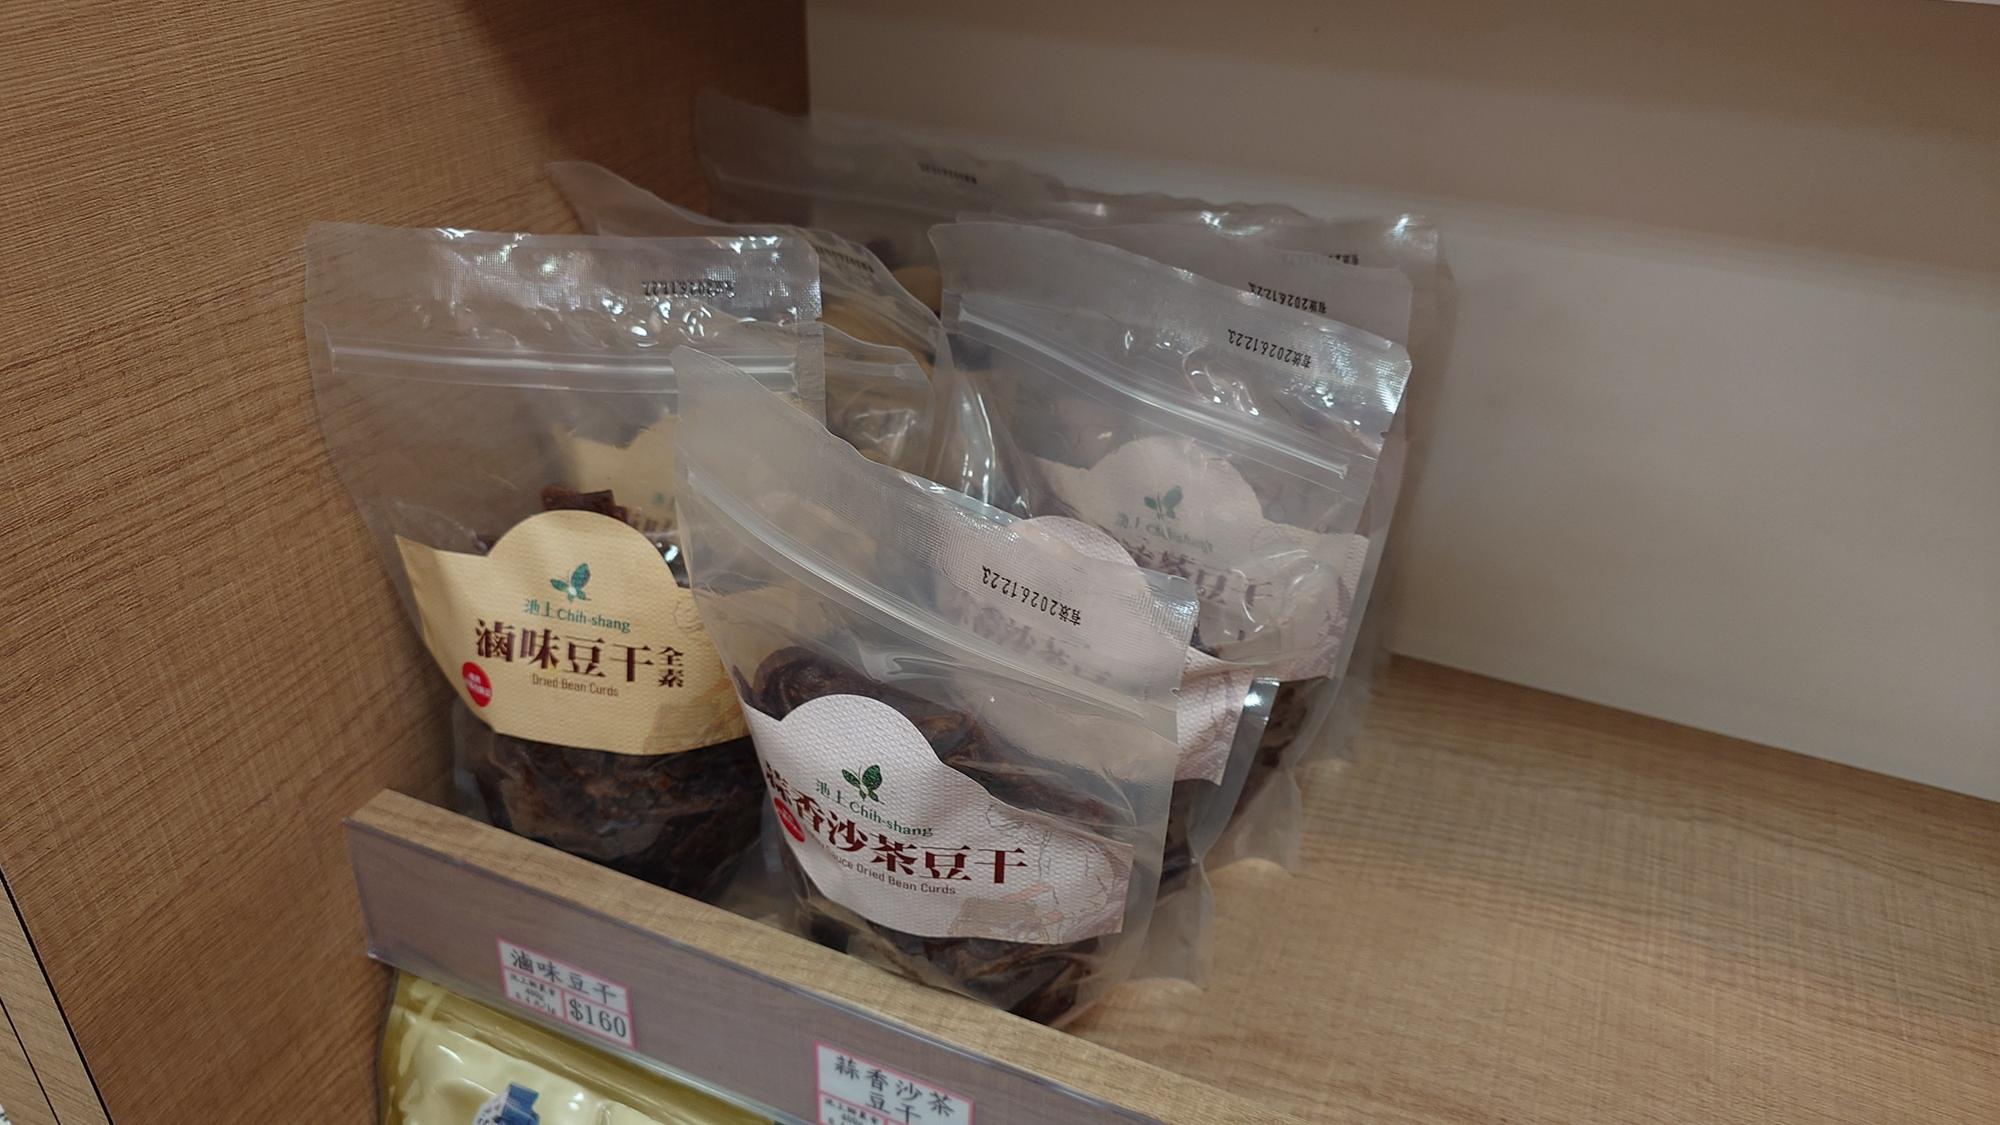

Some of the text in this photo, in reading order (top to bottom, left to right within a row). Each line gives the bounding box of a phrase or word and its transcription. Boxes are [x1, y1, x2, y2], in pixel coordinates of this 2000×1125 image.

[557, 607, 631, 633] Chih-shang
[475, 618, 685, 689] 滷味豆干 全素
[532, 673, 619, 697] Dried Bean Curds
[849, 802, 934, 838] Chih-shang
[857, 863, 885, 882] Dried
[888, 875, 917, 892] Bean
[920, 882, 956, 895] Curds
[510, 950, 616, 1003] 滷味豆干
[570, 998, 626, 1037] $160
[834, 1055, 955, 1117] 蒜香沙茶
[866, 1092, 921, 1125] 豆干
